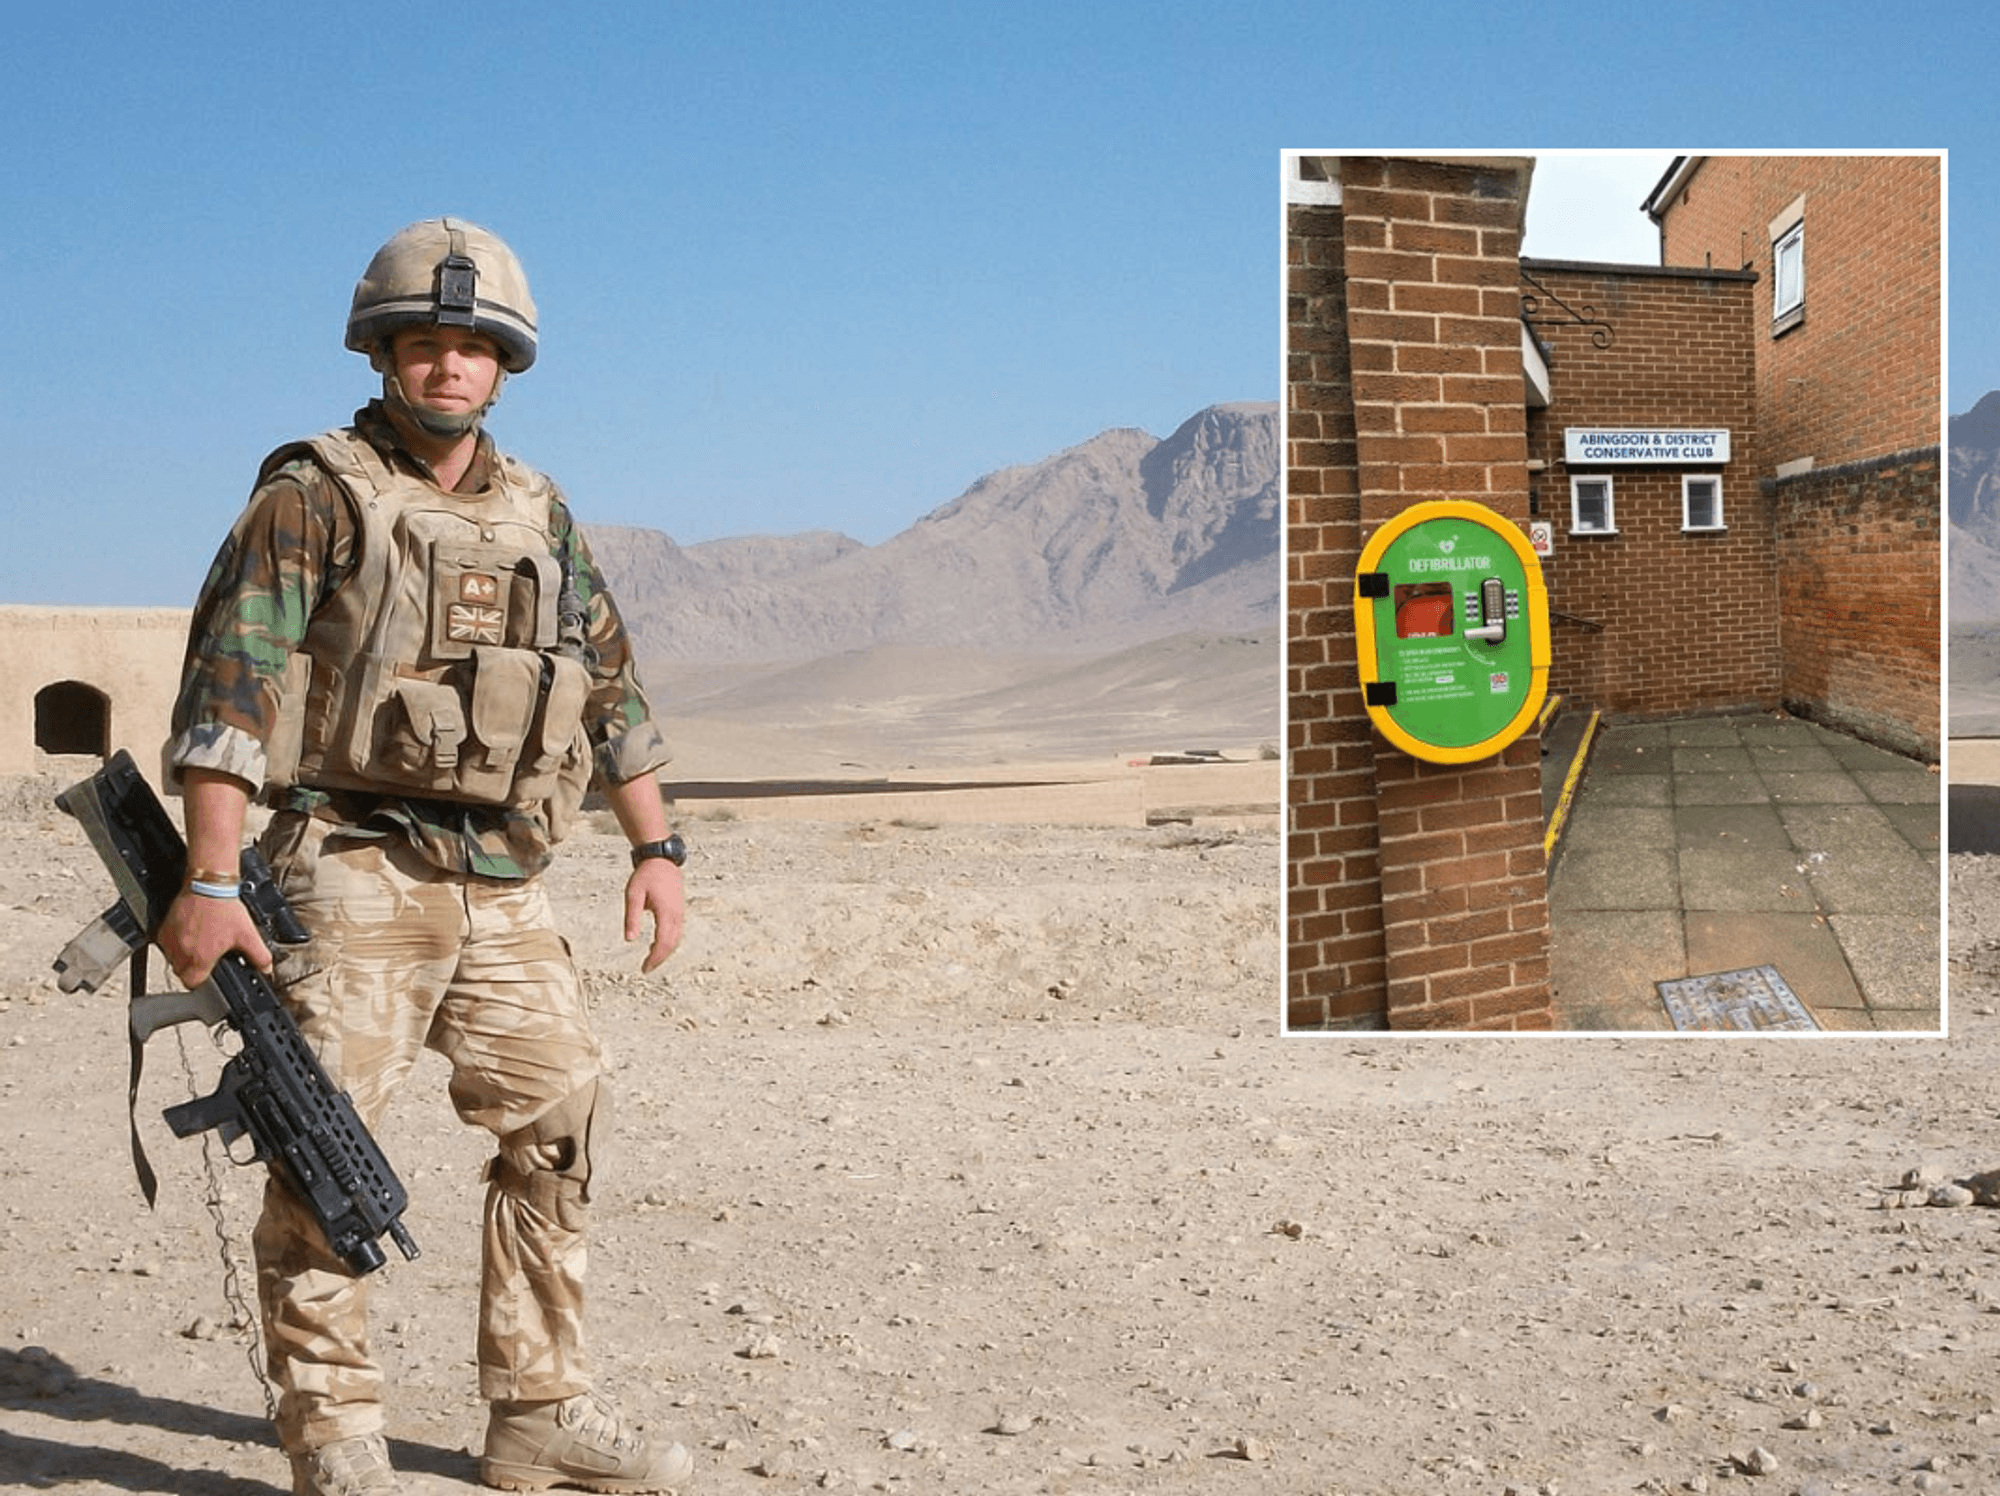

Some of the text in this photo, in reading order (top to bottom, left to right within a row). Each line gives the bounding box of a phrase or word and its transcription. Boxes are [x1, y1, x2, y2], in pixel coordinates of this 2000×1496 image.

[1579, 434, 1717, 446] ABINGDON & DISTRICT
[1584, 447, 1714, 459] CONSERVATIVE CLUB
[1408, 556, 1491, 573] DEFIBRILLATOR
